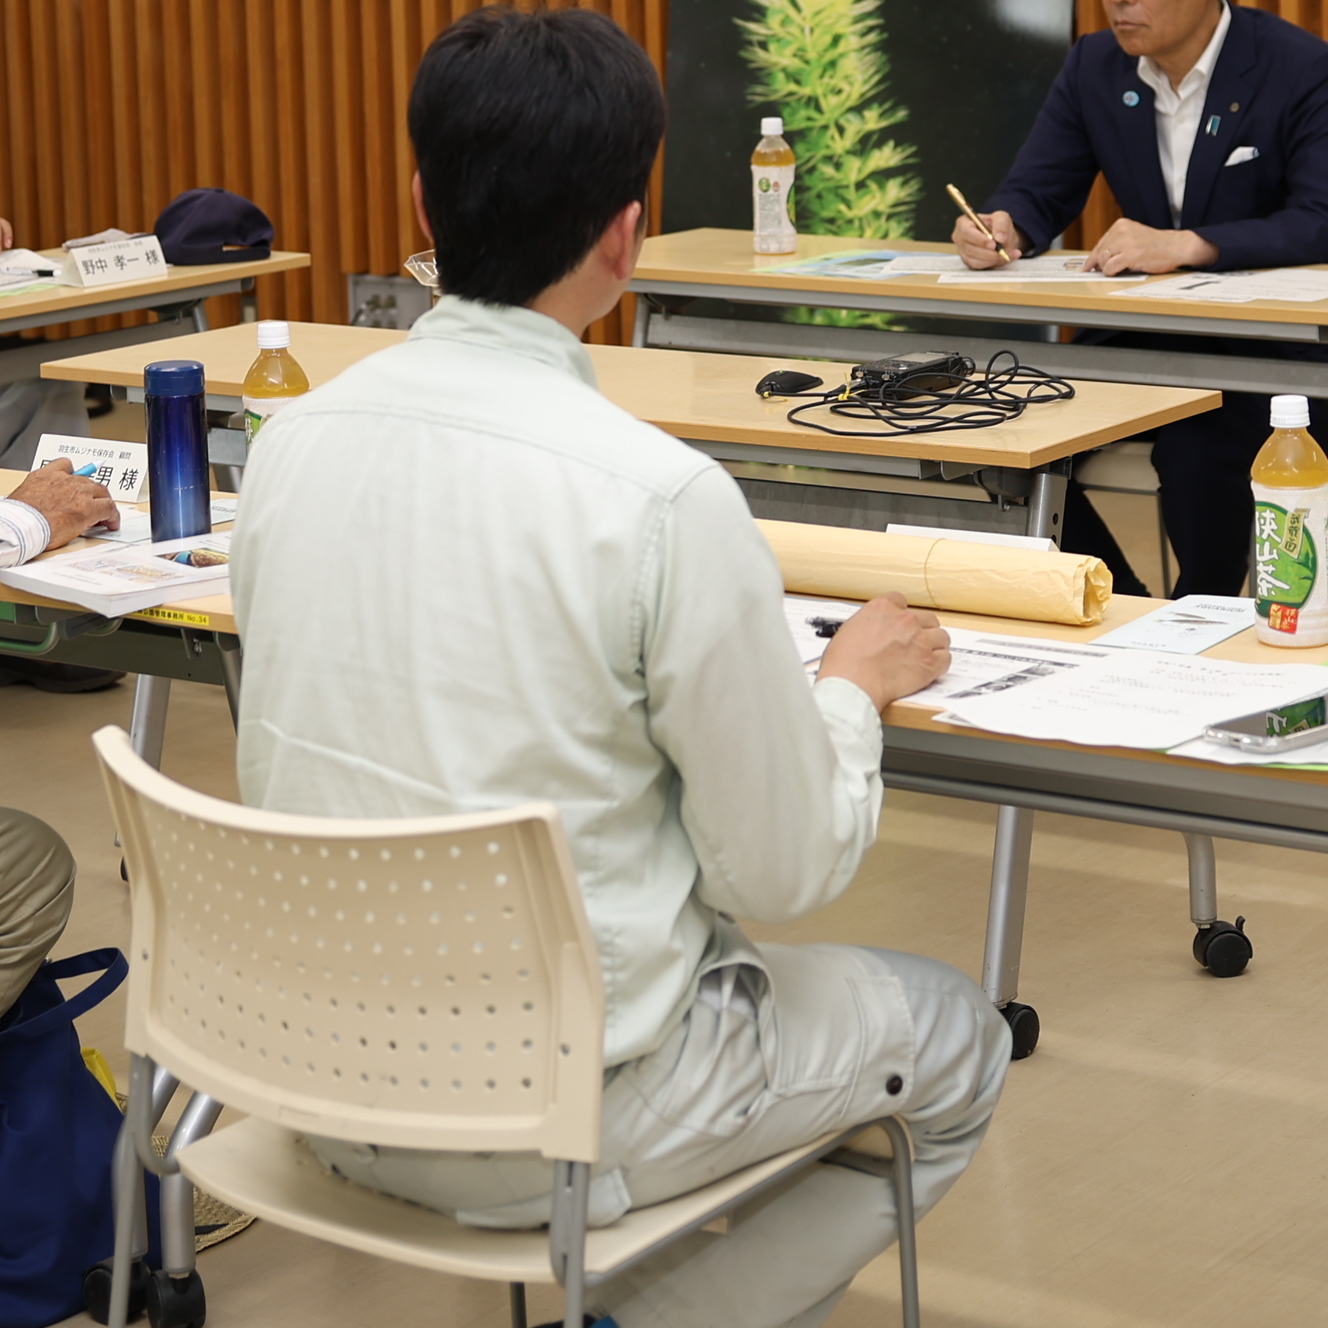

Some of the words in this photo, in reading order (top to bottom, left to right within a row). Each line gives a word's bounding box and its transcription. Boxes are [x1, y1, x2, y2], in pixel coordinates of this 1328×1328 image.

[82, 258, 108, 275] 野中
[114, 254, 139, 270] 孝一
[145, 248, 160, 265] 様
[58, 444, 116, 459] 羽生市ムジナモ保存会
[118, 467, 140, 491] 様
[1255, 509, 1291, 598] 狭山茶
[186, 615, 207, 624] No.34
